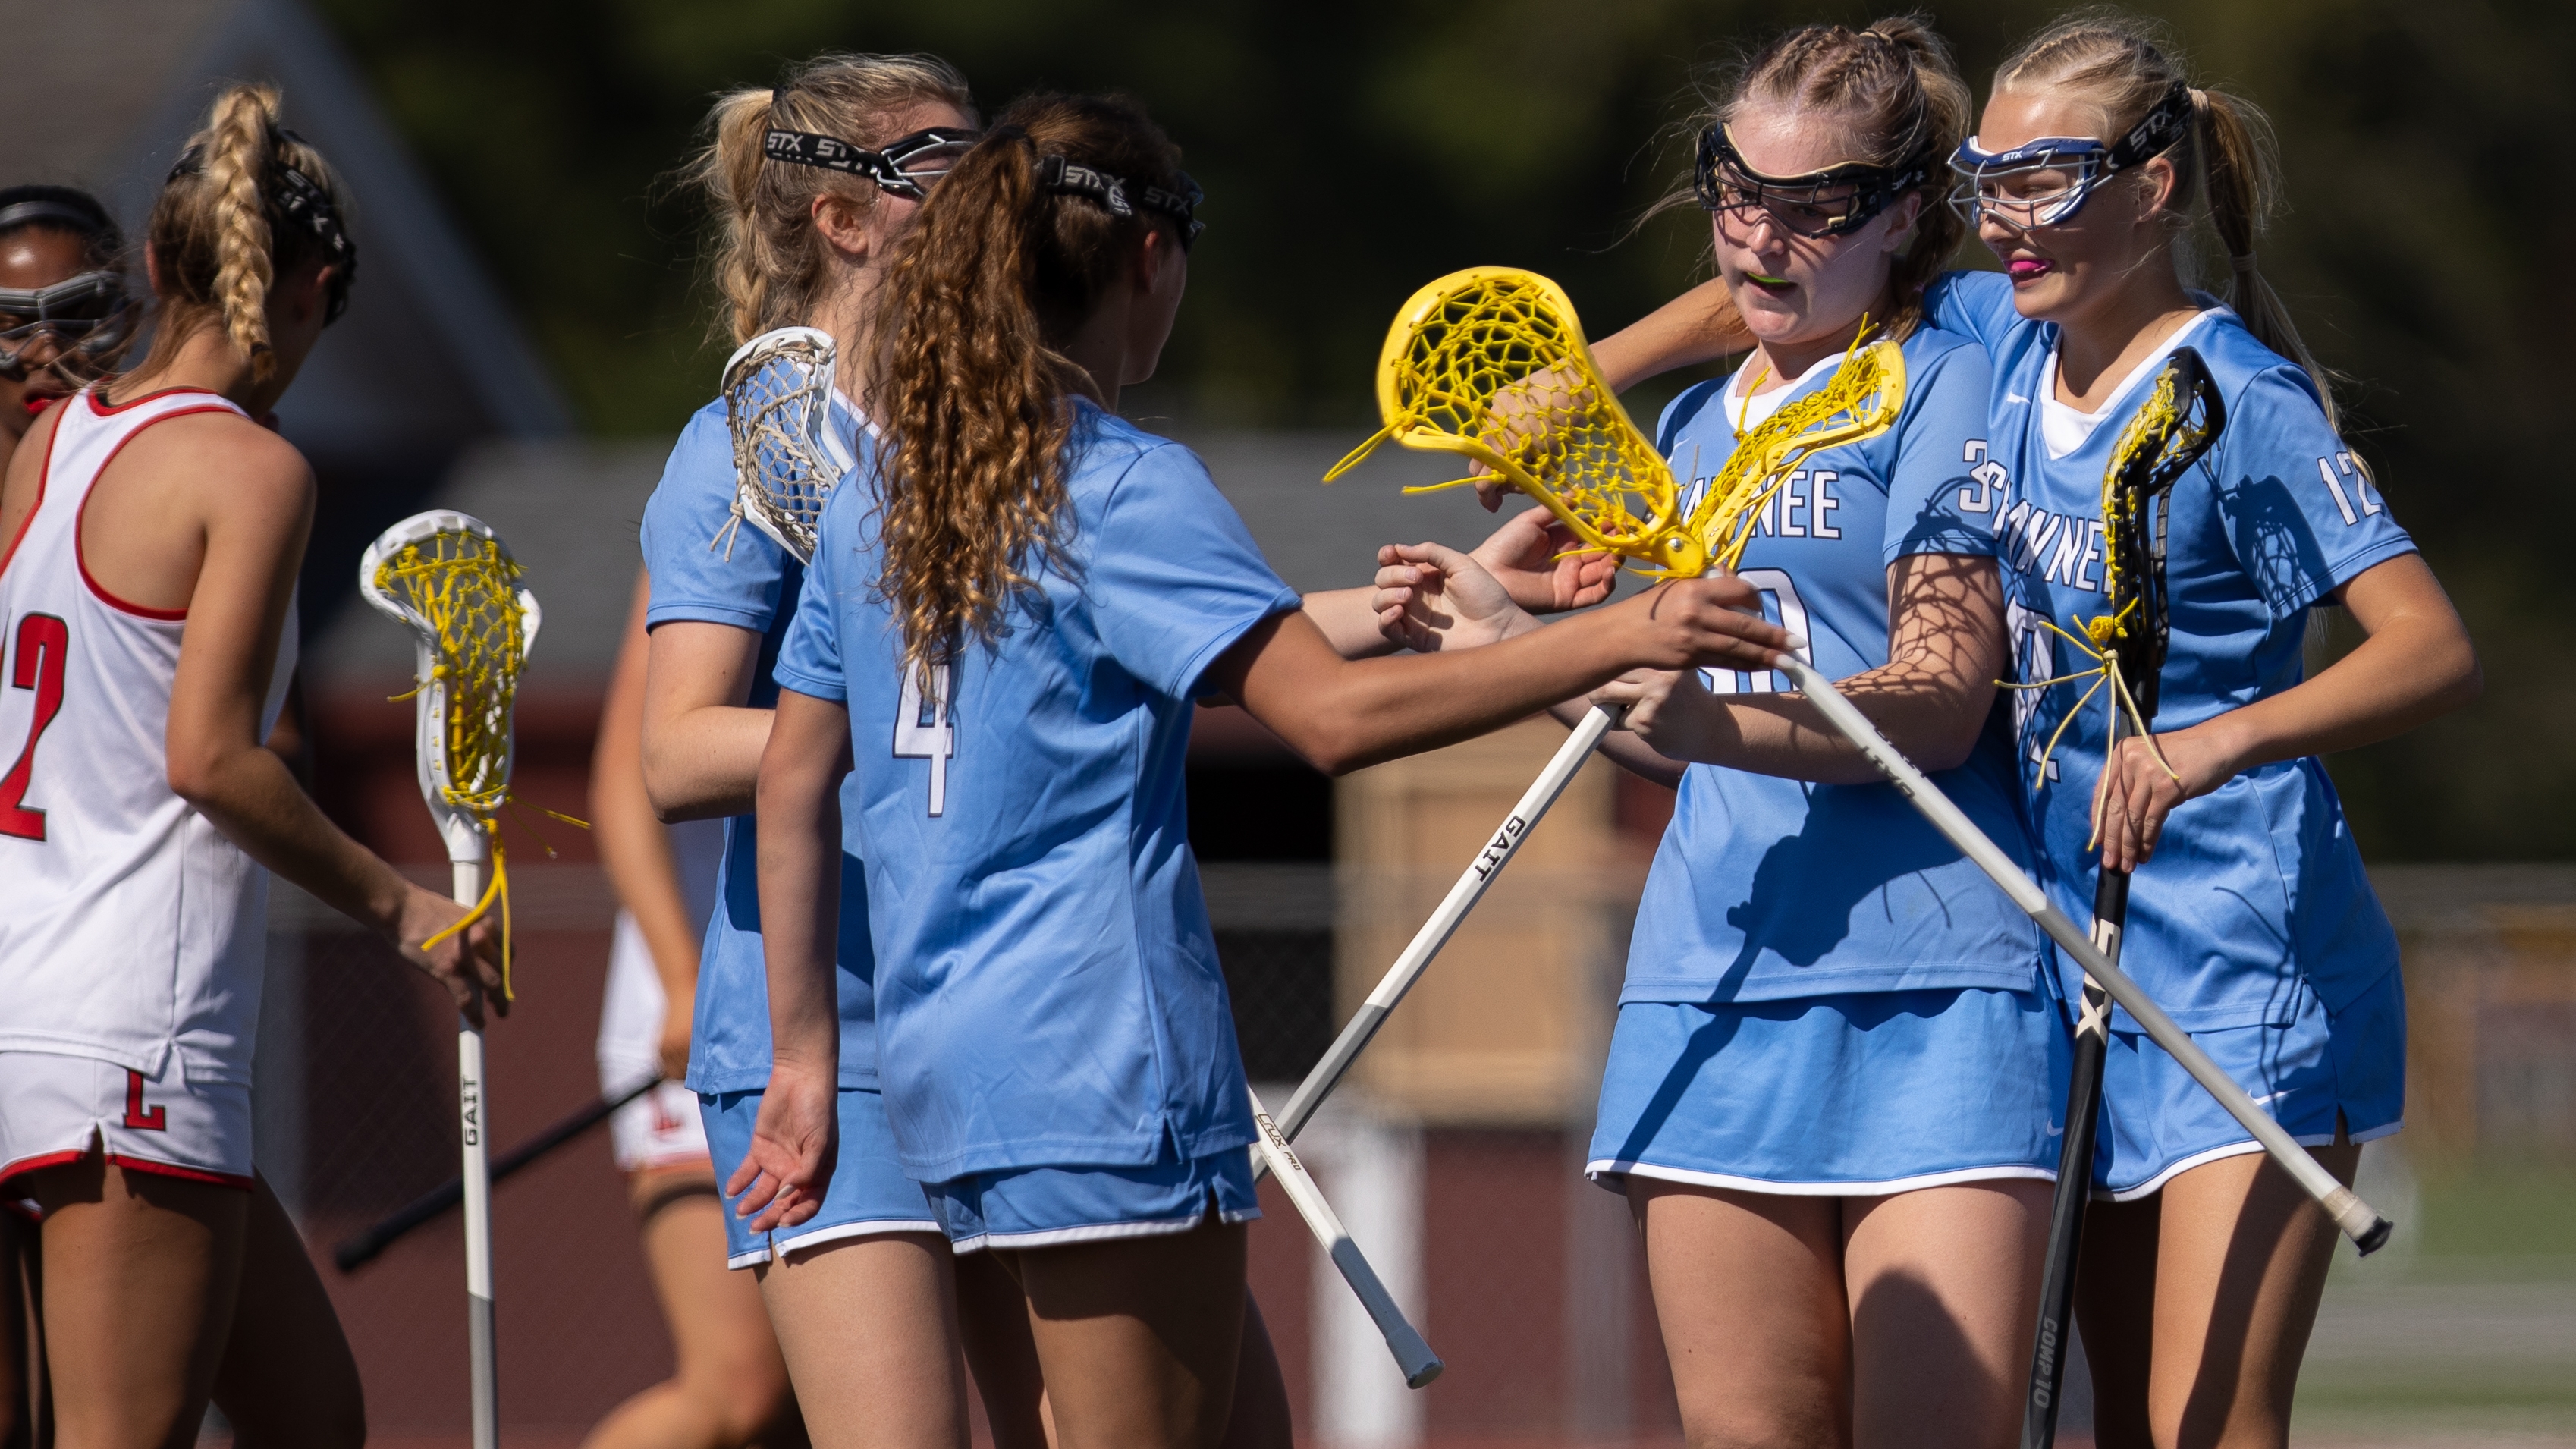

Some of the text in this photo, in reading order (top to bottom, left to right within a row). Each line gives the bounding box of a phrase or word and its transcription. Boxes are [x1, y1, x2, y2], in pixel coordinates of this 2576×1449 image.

[767, 131, 803, 152] STX
[2002, 149, 2023, 162] STX
[2317, 451, 2385, 527] 12
[0, 609, 69, 843] 2
[892, 655, 954, 818] 4
[1474, 815, 1526, 882] GAIT
[123, 1068, 166, 1131] L
[463, 1075, 478, 1146] GAIT
[1283, 1151, 1302, 1171] PRO
[2034, 1316, 2058, 1409] COMP 10
